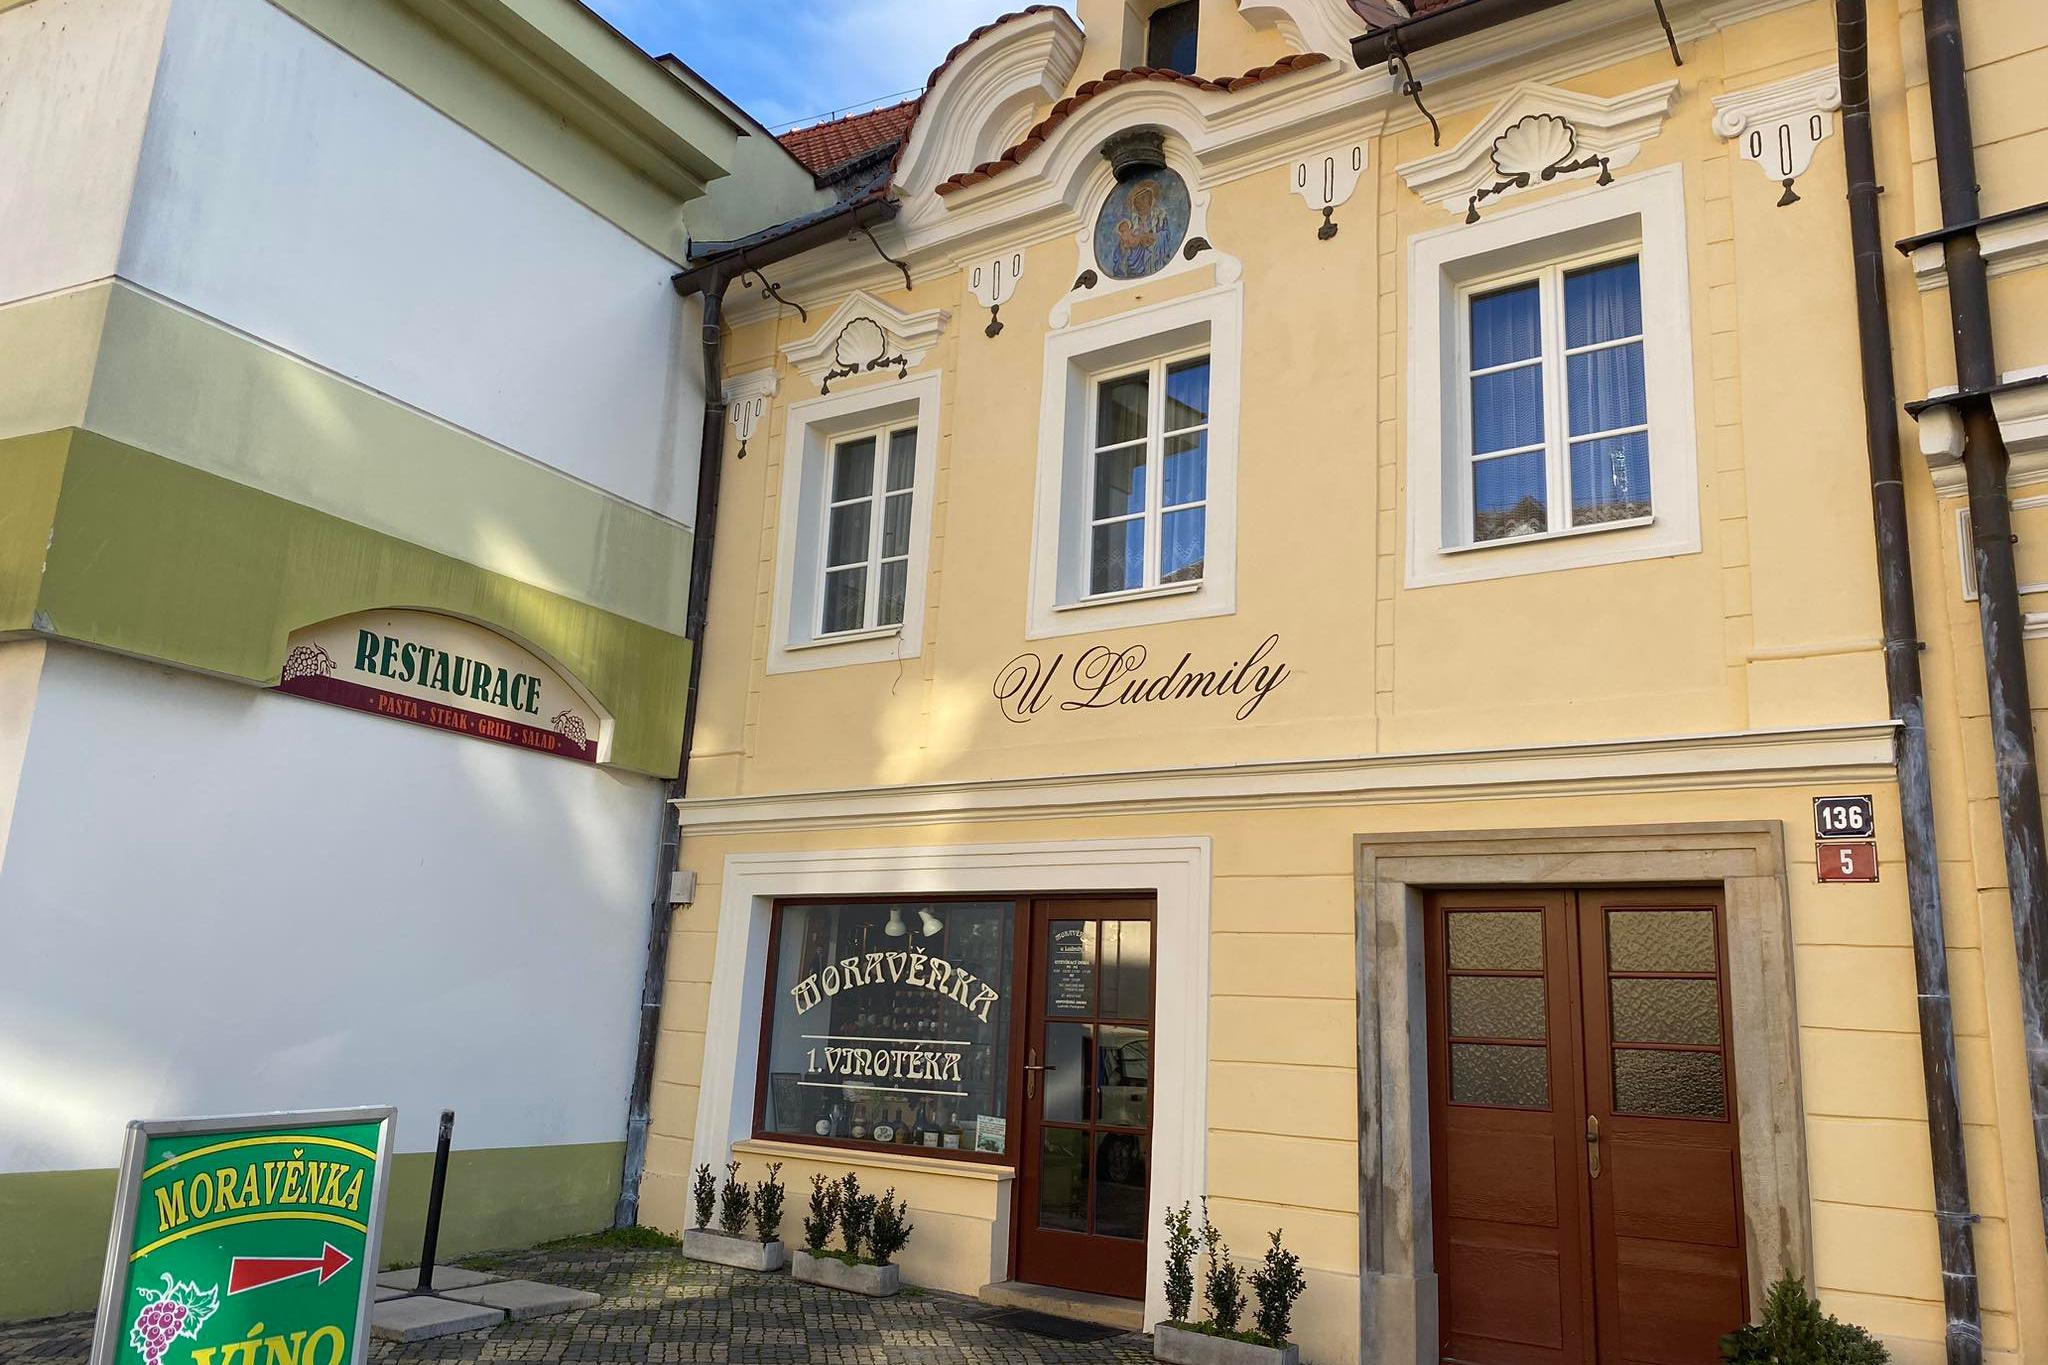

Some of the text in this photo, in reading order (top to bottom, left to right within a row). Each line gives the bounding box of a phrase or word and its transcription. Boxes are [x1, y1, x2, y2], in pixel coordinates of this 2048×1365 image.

[354, 629, 542, 715] RESTAURACE
[992, 633, 1291, 724] U Ludmily
[378, 694, 557, 751] PASTA STEAK GRILL SALAD
[1822, 805, 1863, 830] 136
[1839, 848, 1854, 875] 5
[790, 946, 1000, 1024] MORAVĚNKA
[806, 1044, 962, 1082] 1. VINOTÉKA
[154, 1147, 365, 1233] MORAVĚNKA
